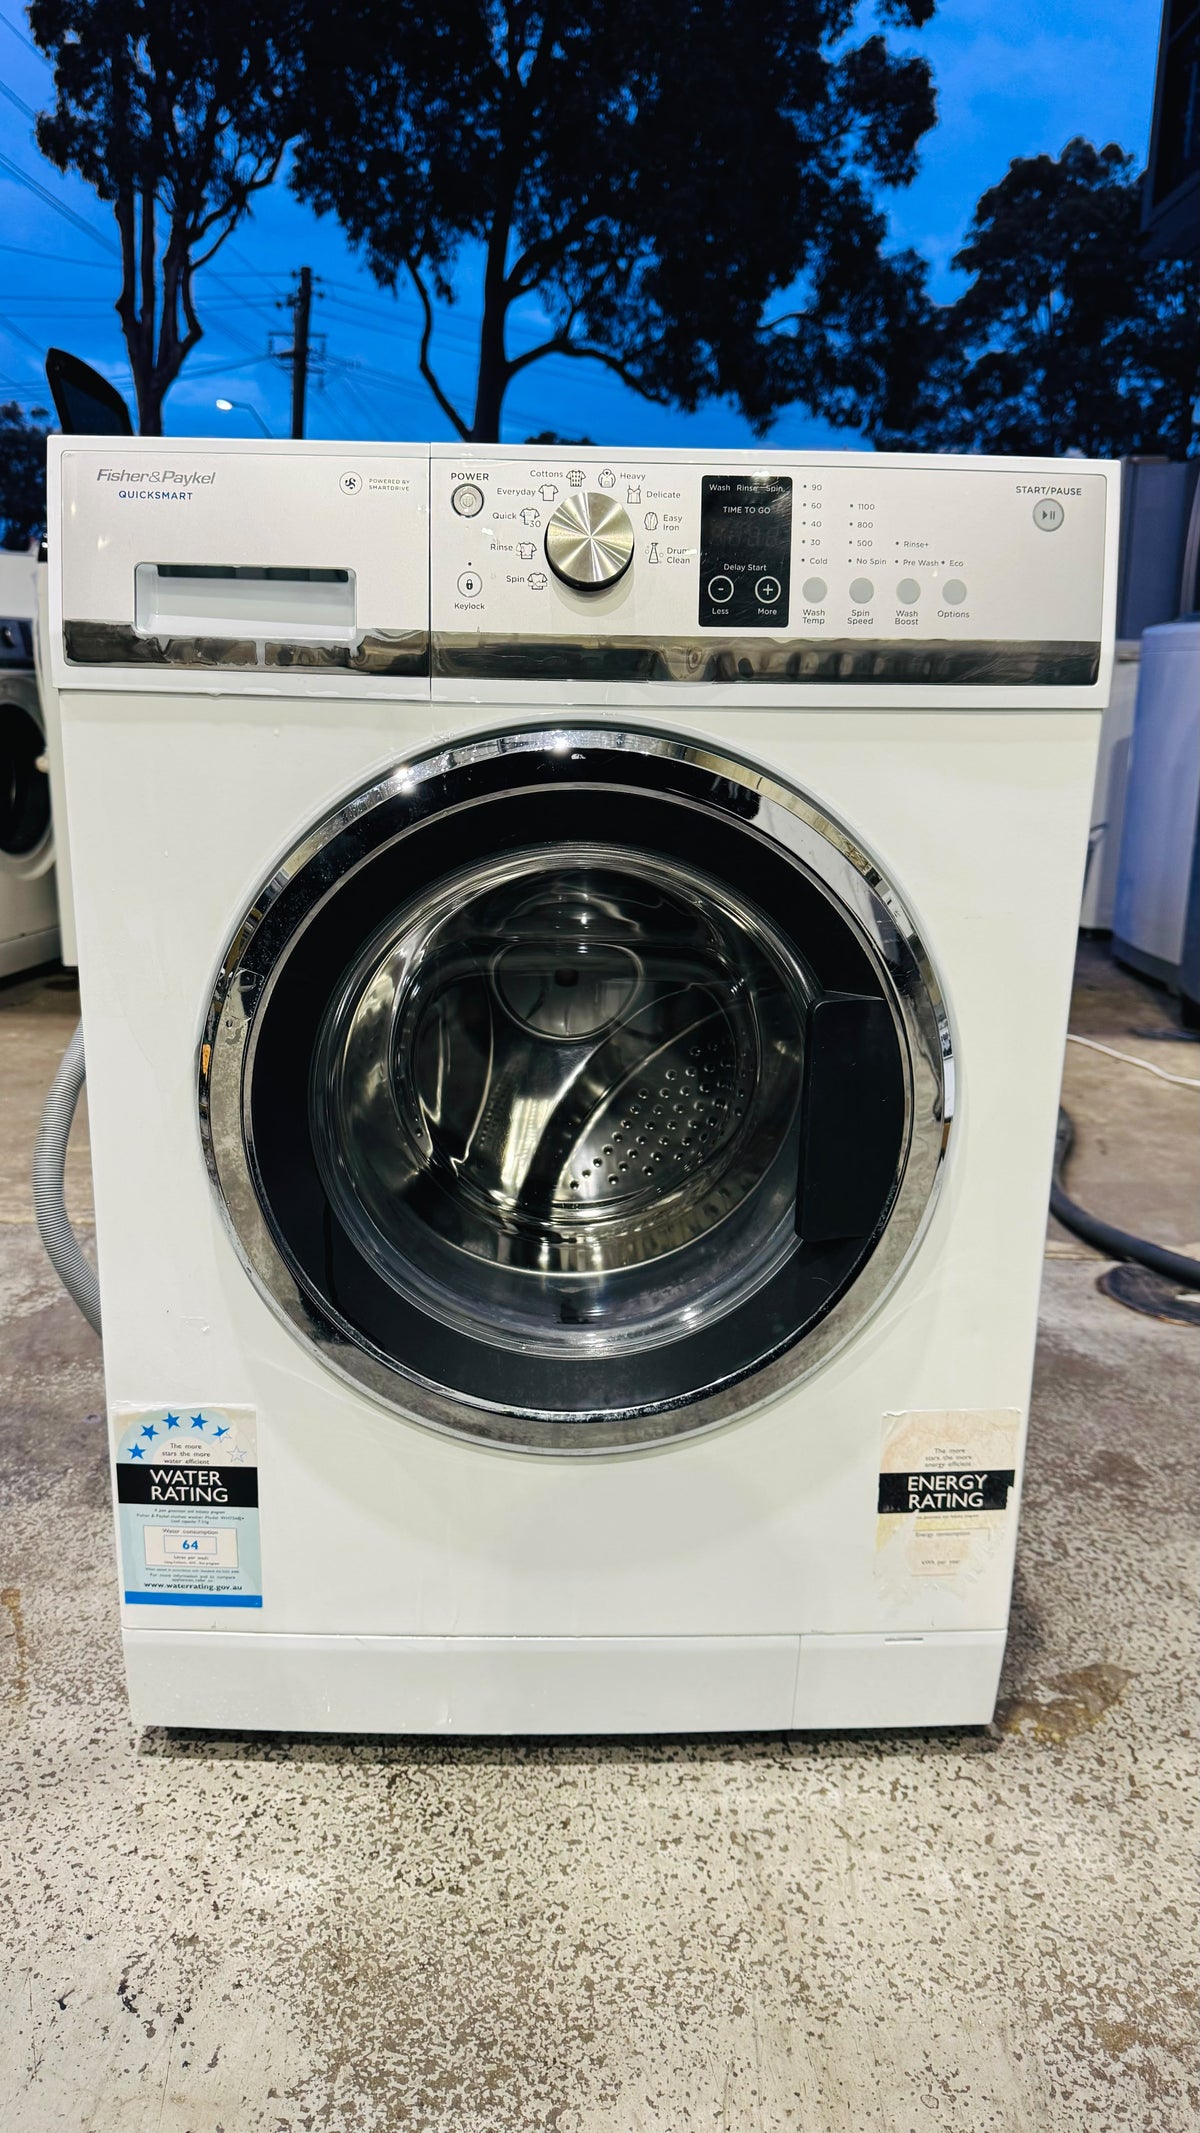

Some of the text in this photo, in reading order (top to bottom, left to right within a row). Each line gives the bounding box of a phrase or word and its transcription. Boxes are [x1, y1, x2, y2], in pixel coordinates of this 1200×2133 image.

[450, 472, 490, 481] POWER
[530, 470, 564, 479] Cottons
[620, 472, 646, 481] Heavy
[496, 488, 536, 497] Everyday
[709, 484, 731, 492] Wash
[737, 484, 758, 492] Rinse
[1015, 485, 1082, 496] START/PAUSE
[118, 490, 193, 500] QUICKSMART
[646, 490, 681, 499] Delicate
[723, 506, 771, 515] TIME TO GO
[858, 503, 875, 511] 1100
[492, 511, 517, 520] Quick
[663, 514, 683, 523] Easy
[530, 520, 541, 528] 30
[663, 523, 680, 531] Iron
[810, 520, 822, 528] 40
[857, 521, 873, 529] 800
[810, 538, 821, 546] 30
[903, 540, 929, 548] Rinse+
[490, 543, 513, 551] Rinse
[667, 556, 690, 564] Clean
[809, 557, 828, 565] Cold
[869, 558, 887, 567] Spin
[903, 559, 939, 567] Pre Wash
[723, 563, 746, 572] Delay
[506, 575, 525, 584] Spin
[454, 602, 485, 611] Keylock
[802, 609, 826, 617] Wash
[851, 609, 870, 618] Spin
[895, 609, 919, 617] Wash
[937, 610, 970, 619] Options
[802, 617, 826, 625] Temp
[847, 617, 874, 626] Speed
[894, 617, 919, 626] Boost
[149, 1469, 222, 1486] WATER
[907, 1474, 988, 1491] ENERGY
[151, 1486, 229, 1503] RATING
[908, 1492, 984, 1509] RATING
[182, 1540, 199, 1550] 64
[144, 1582, 243, 1592] www.waterrating.gov.au
